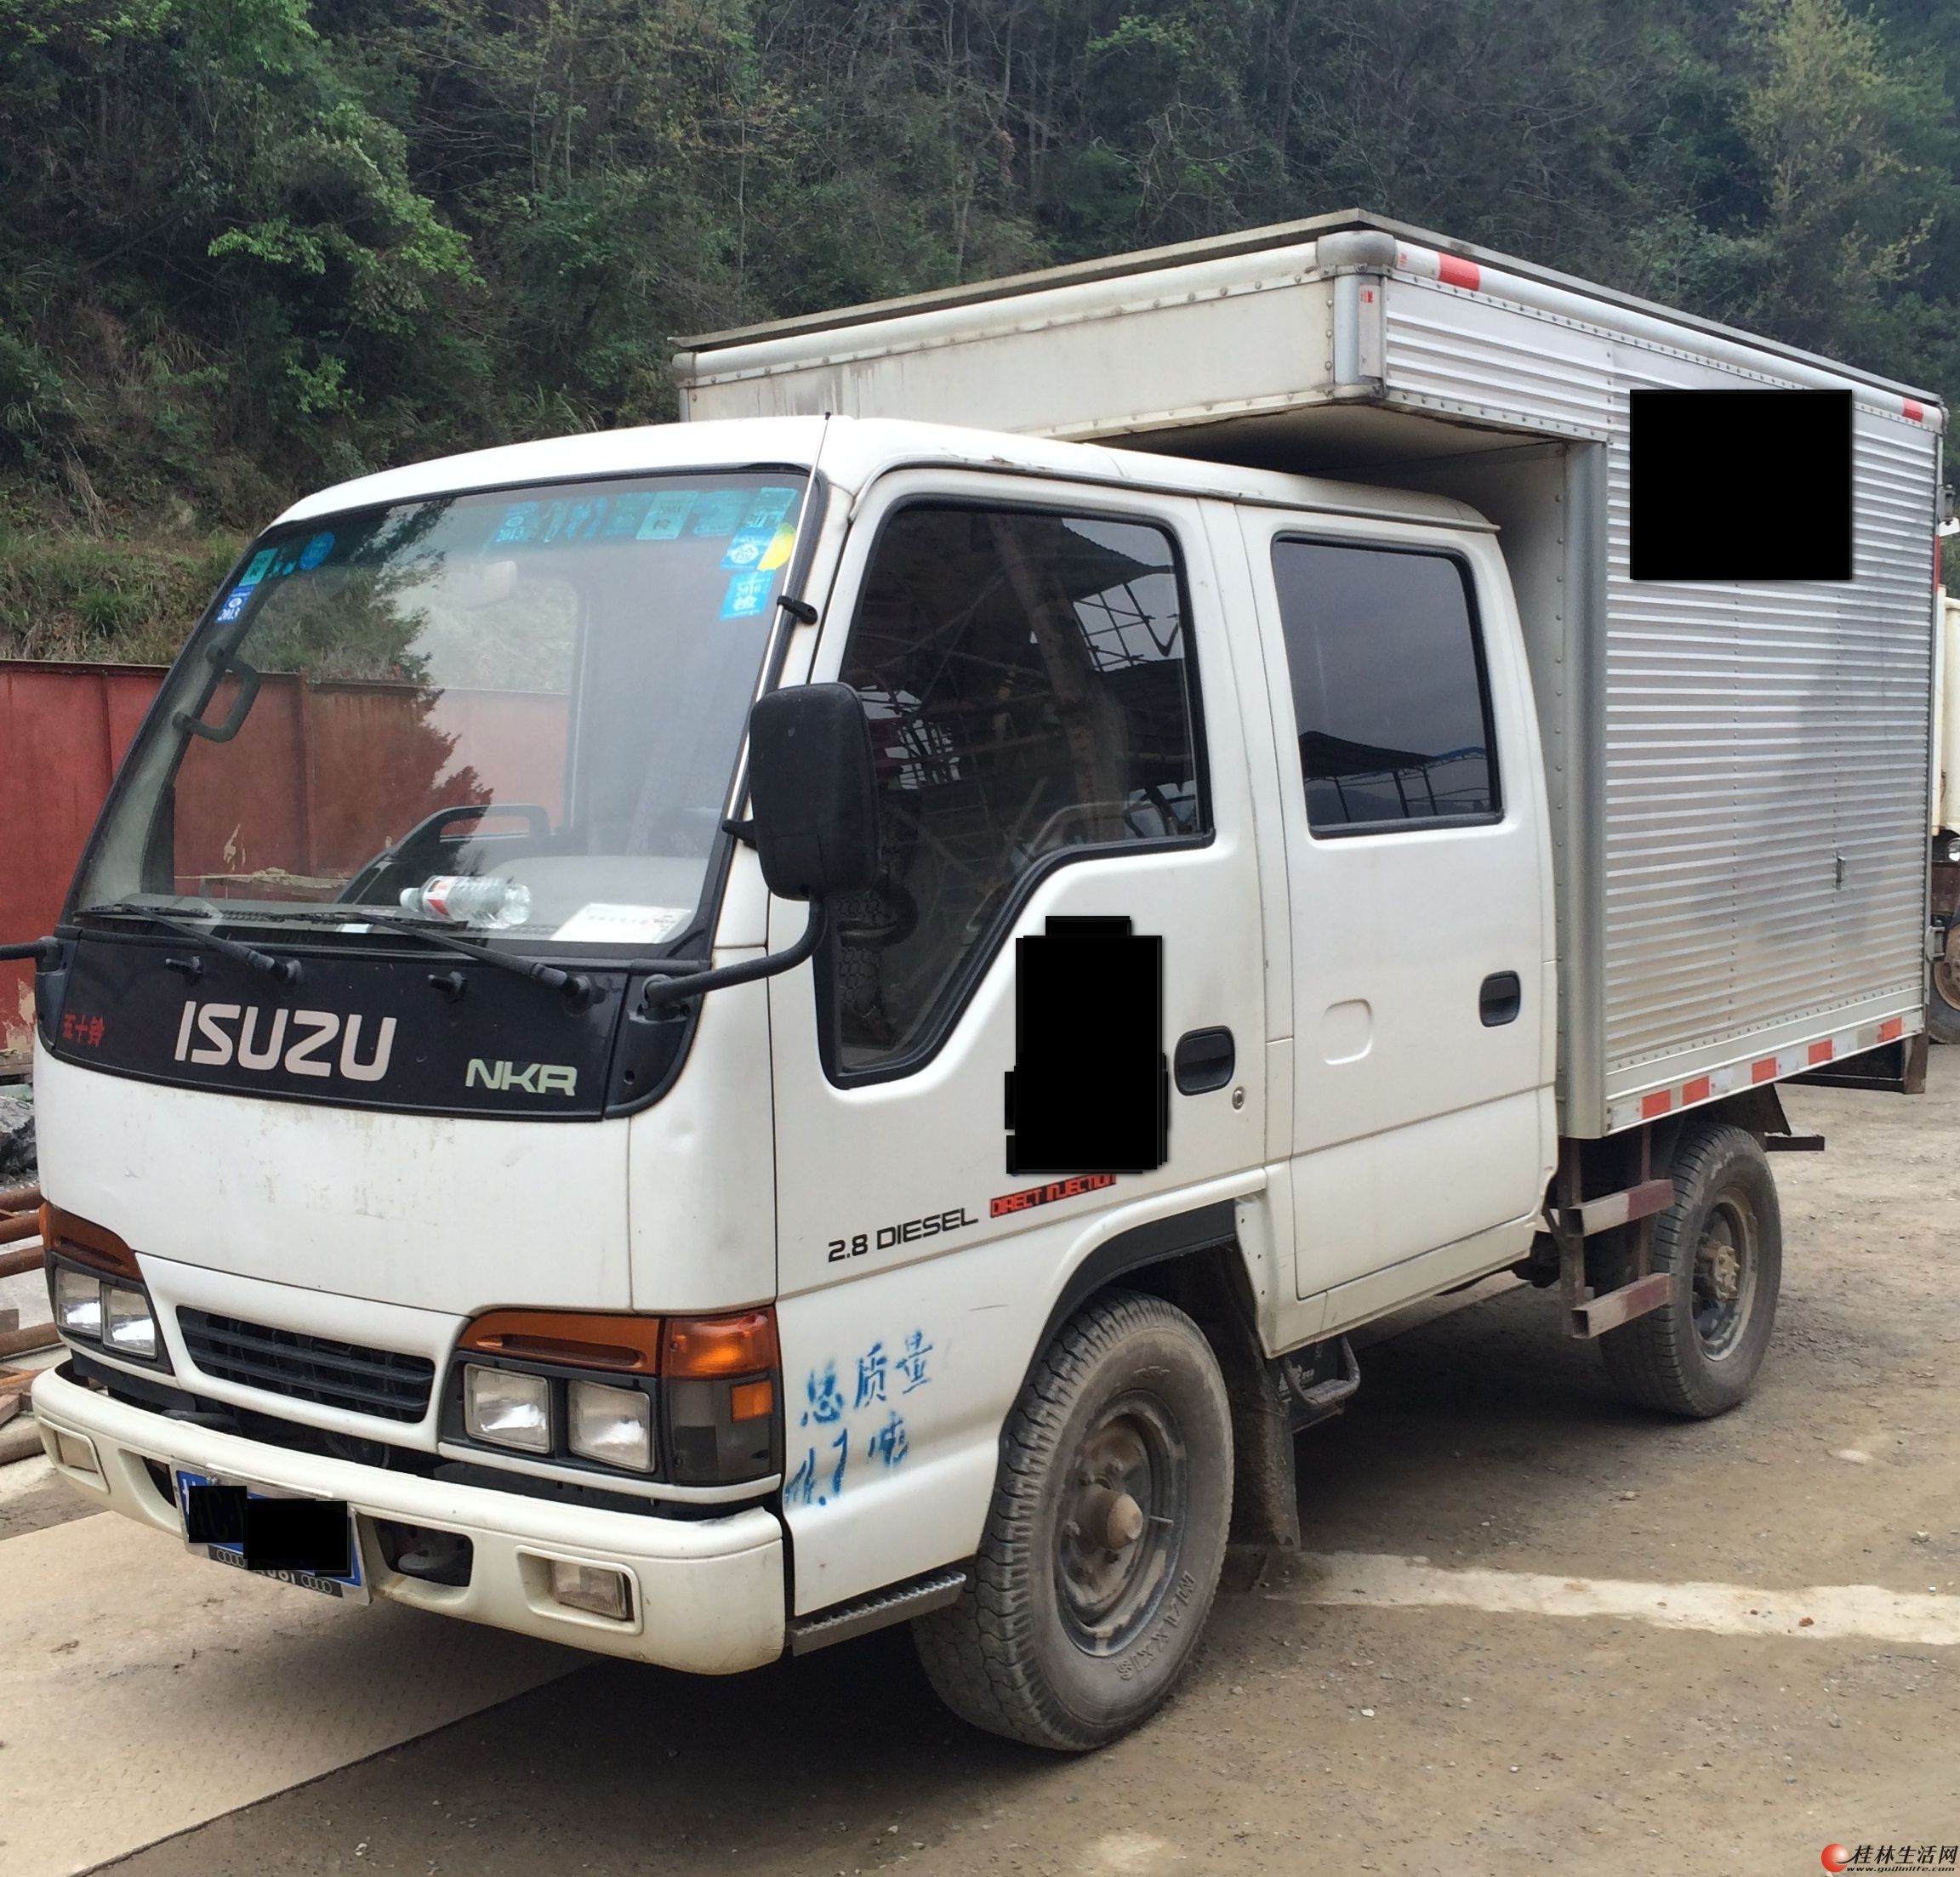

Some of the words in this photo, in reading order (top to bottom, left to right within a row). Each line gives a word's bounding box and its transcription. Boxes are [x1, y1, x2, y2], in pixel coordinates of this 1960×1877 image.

[174, 1000, 398, 1083] ISUZU
[464, 1058, 578, 1097] NKR
[828, 1233, 869, 1262] 2.8
[876, 1208, 978, 1249] DIESEL
[992, 1189, 1042, 1216] DIRECT
[800, 1329, 933, 1429] 总质量
